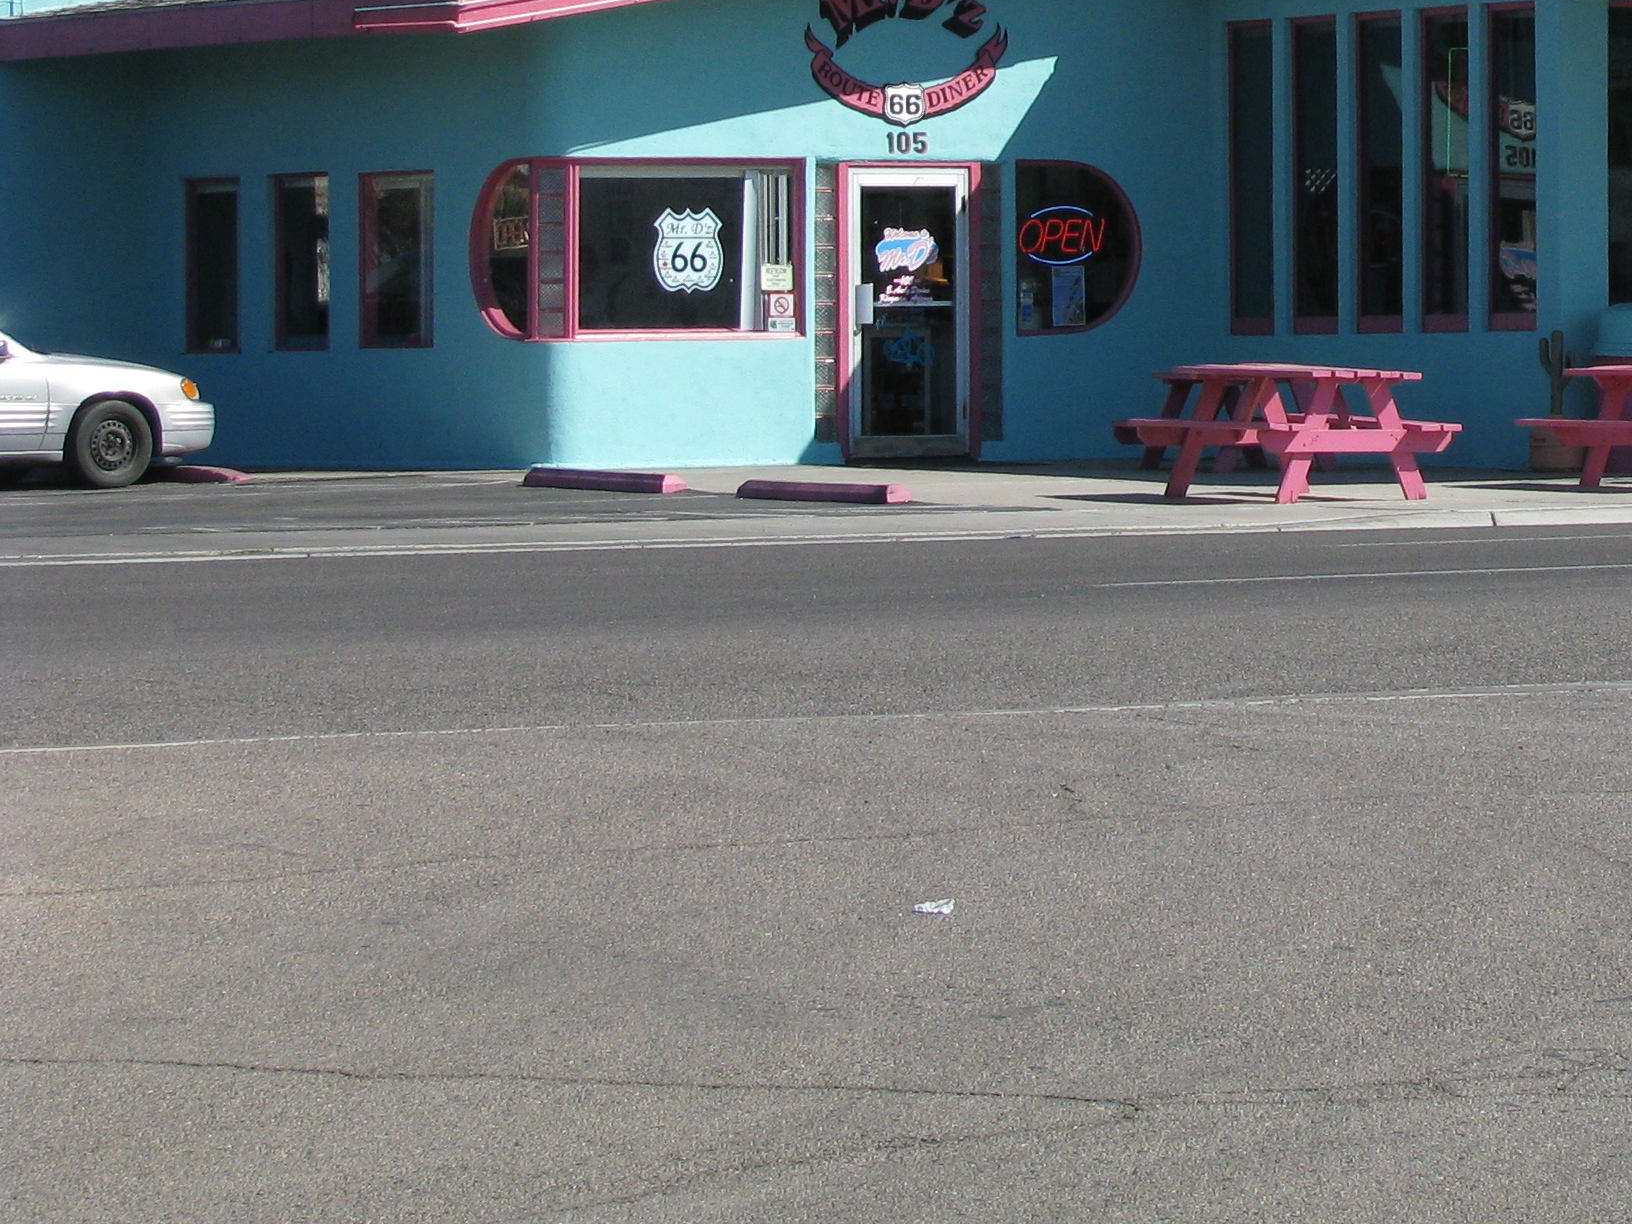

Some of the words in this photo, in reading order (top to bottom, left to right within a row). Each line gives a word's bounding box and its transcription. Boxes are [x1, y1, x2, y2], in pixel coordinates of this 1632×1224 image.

[817, 61, 880, 107] ROUTE
[889, 93, 921, 116] 66
[926, 65, 988, 109] DINER
[886, 131, 928, 155] 105
[666, 223, 688, 235] Mr.
[691, 222, 713, 235] D'z
[1018, 218, 1106, 253] OPEN
[671, 241, 707, 273] 66
